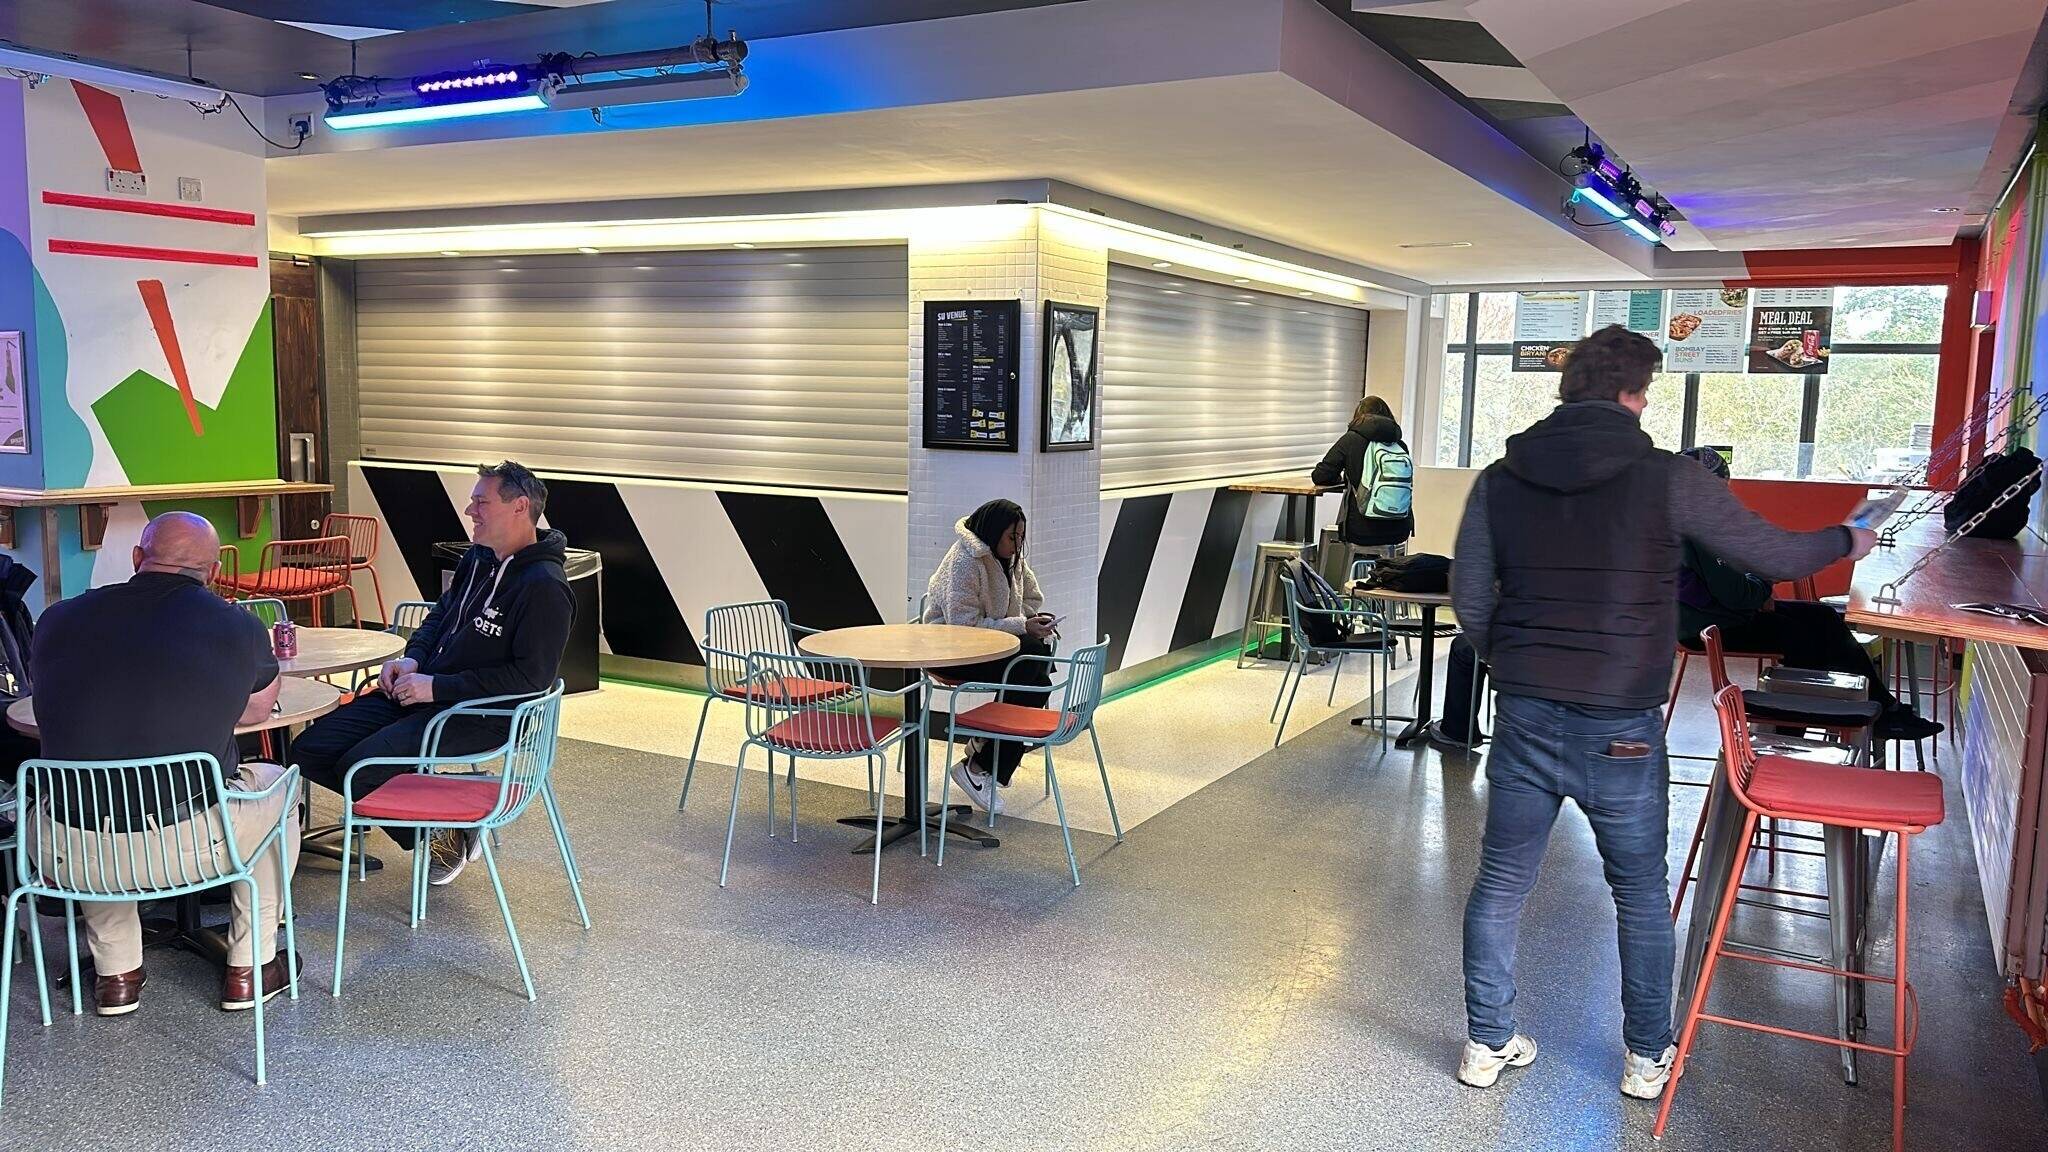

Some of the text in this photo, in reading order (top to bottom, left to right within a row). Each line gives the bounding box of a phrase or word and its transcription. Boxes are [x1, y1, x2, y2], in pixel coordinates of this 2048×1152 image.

[1758, 311, 1813, 324] MEAL DEAL
[473, 616, 502, 636] OETS
